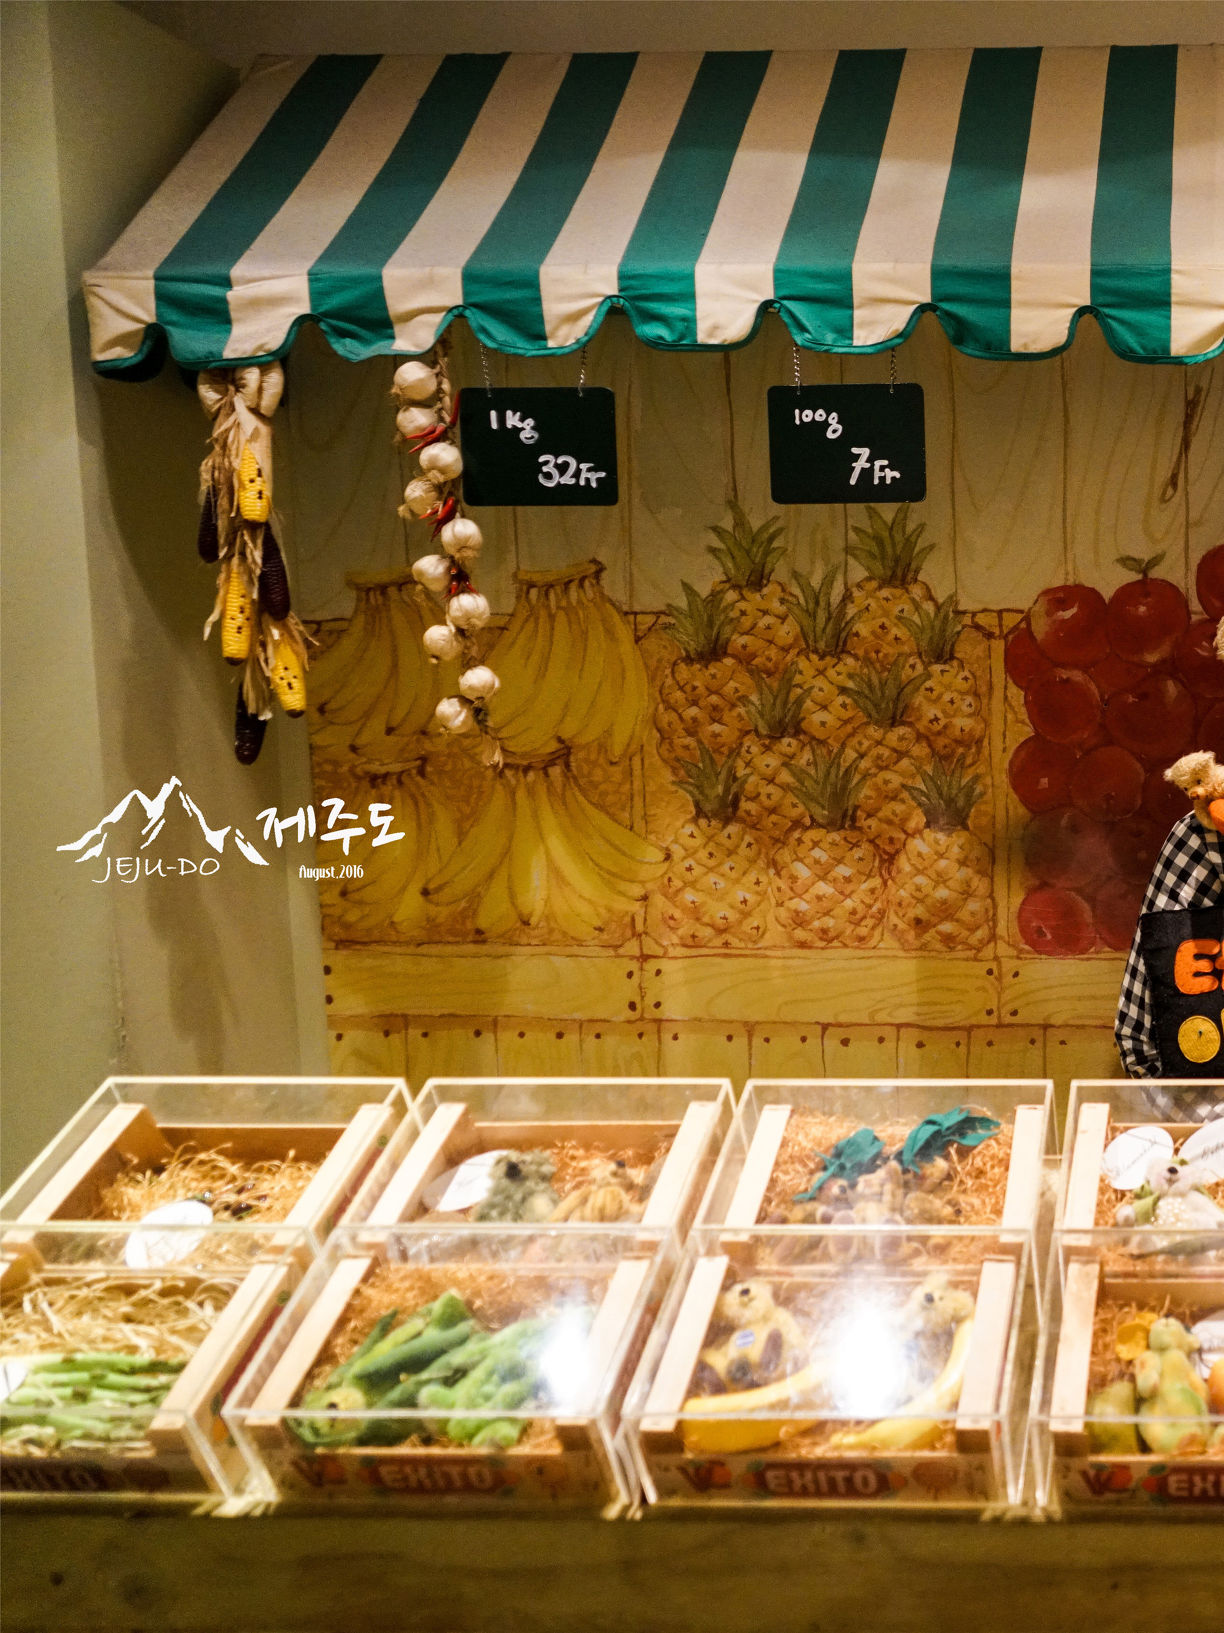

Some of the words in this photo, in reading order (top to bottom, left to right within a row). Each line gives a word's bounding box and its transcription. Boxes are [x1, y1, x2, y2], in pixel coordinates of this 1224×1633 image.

[794, 408, 843, 439] 100g
[537, 454, 607, 489] 32Fr
[849, 447, 901, 486] 7Fr
[377, 1464, 493, 1490] EXITO
[764, 1468, 878, 1495] EXITO
